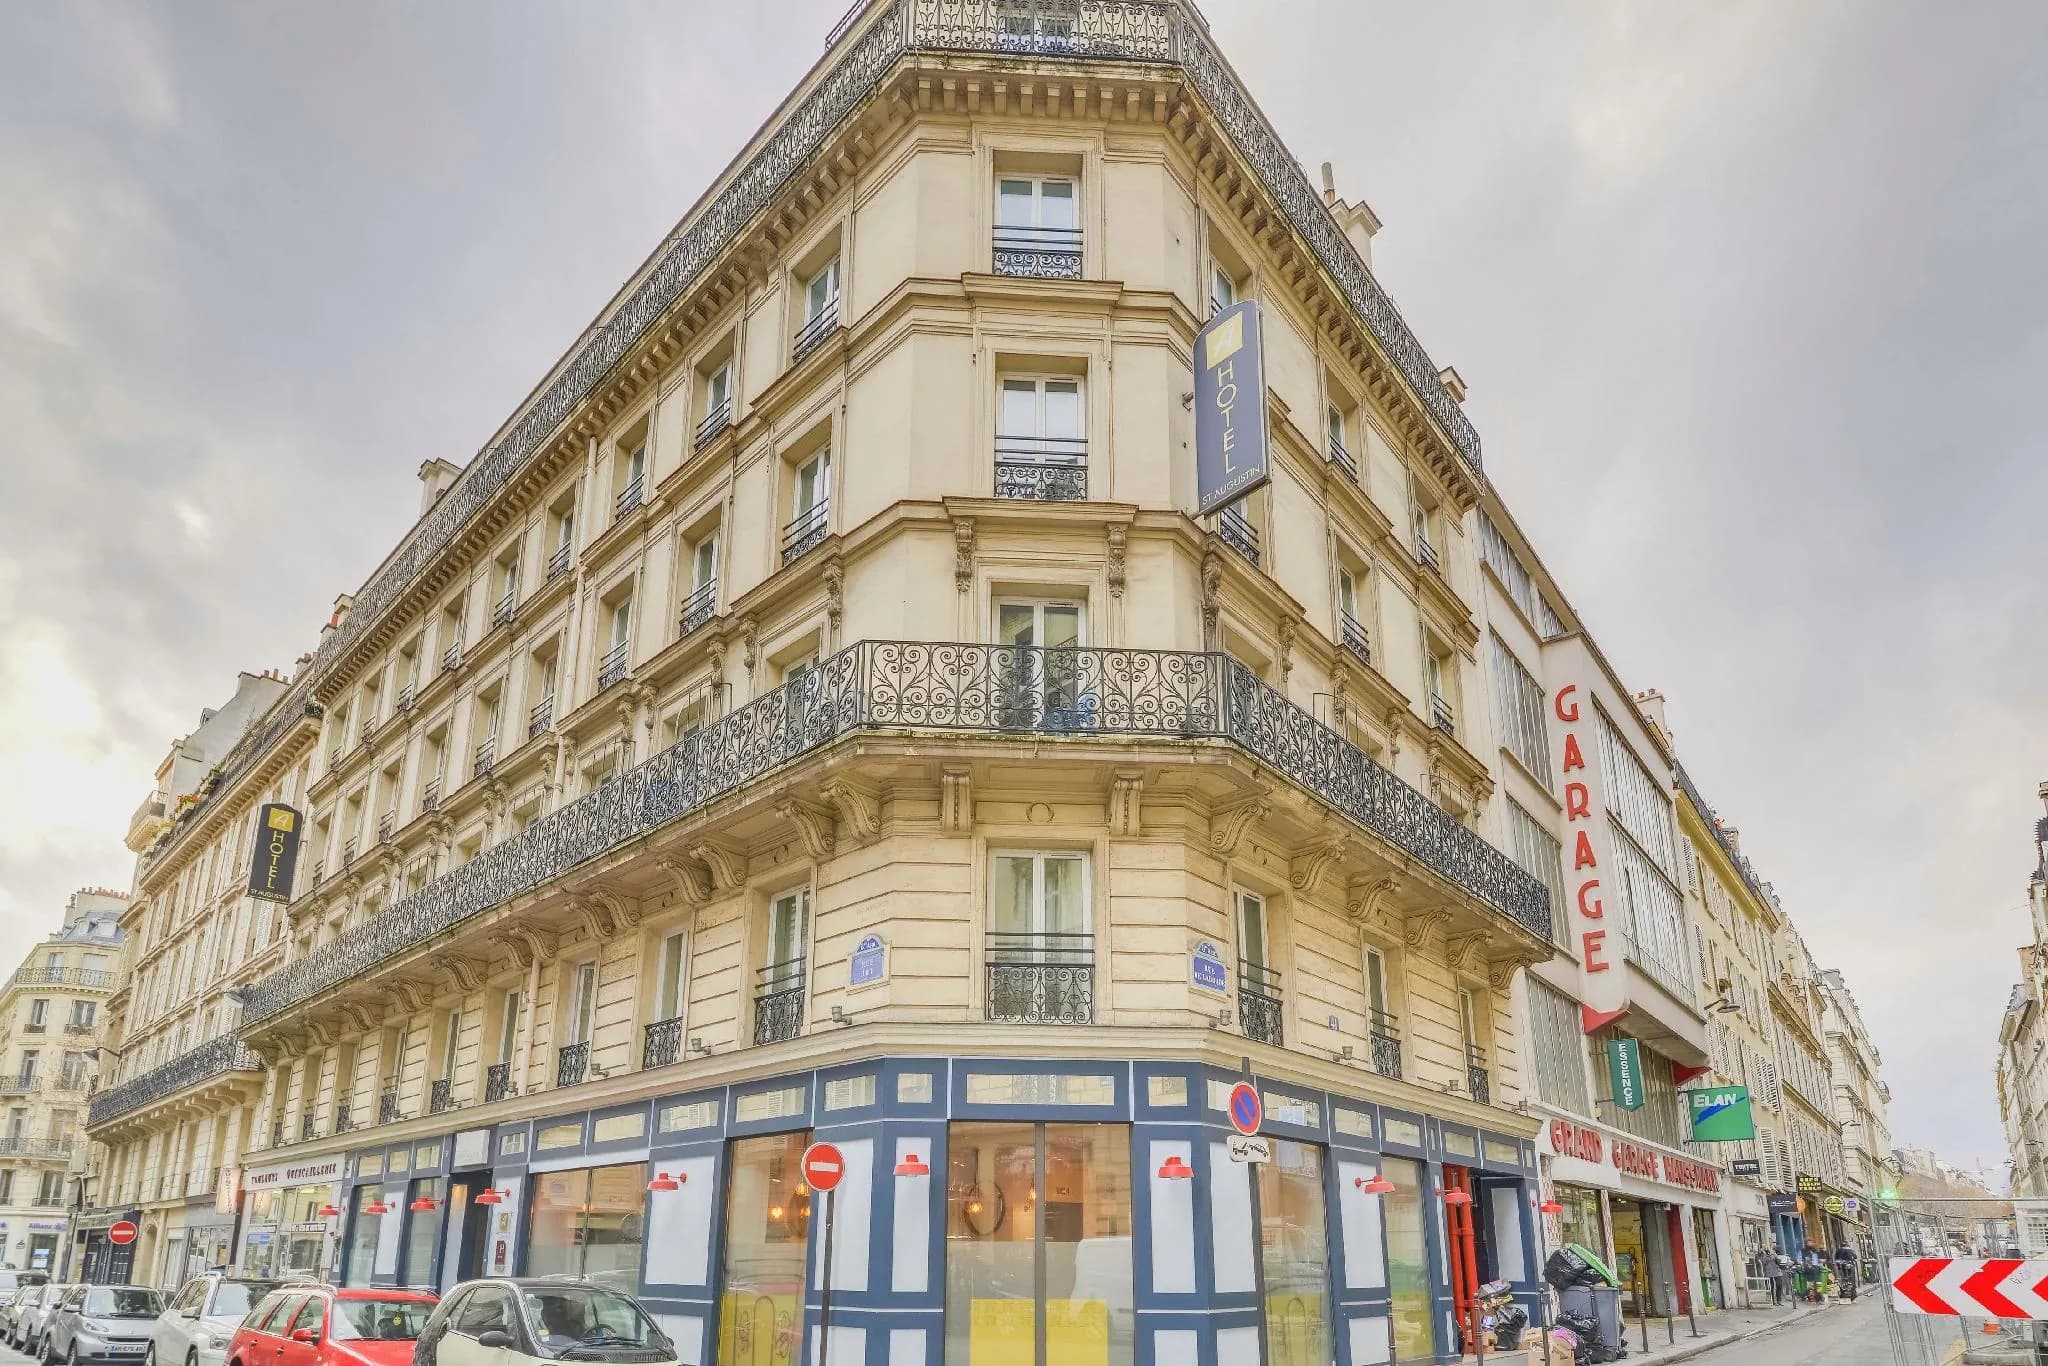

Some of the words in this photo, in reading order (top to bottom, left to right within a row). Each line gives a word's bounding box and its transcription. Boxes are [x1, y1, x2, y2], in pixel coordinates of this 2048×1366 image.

[1216, 360, 1237, 475] HOTEL
[1202, 491, 1212, 505] ST
[1214, 463, 1260, 499] AUGUSTIN
[267, 830, 284, 889] HOTEL
[1554, 684, 1609, 973] GARAGE
[1618, 1043, 1633, 1106] ESSENCE
[1693, 1093, 1737, 1108] ELAN
[1550, 1119, 1603, 1164] GRAND
[1611, 1139, 1659, 1180] GARAGE
[1663, 1155, 1720, 1193] HAUSSMANN
